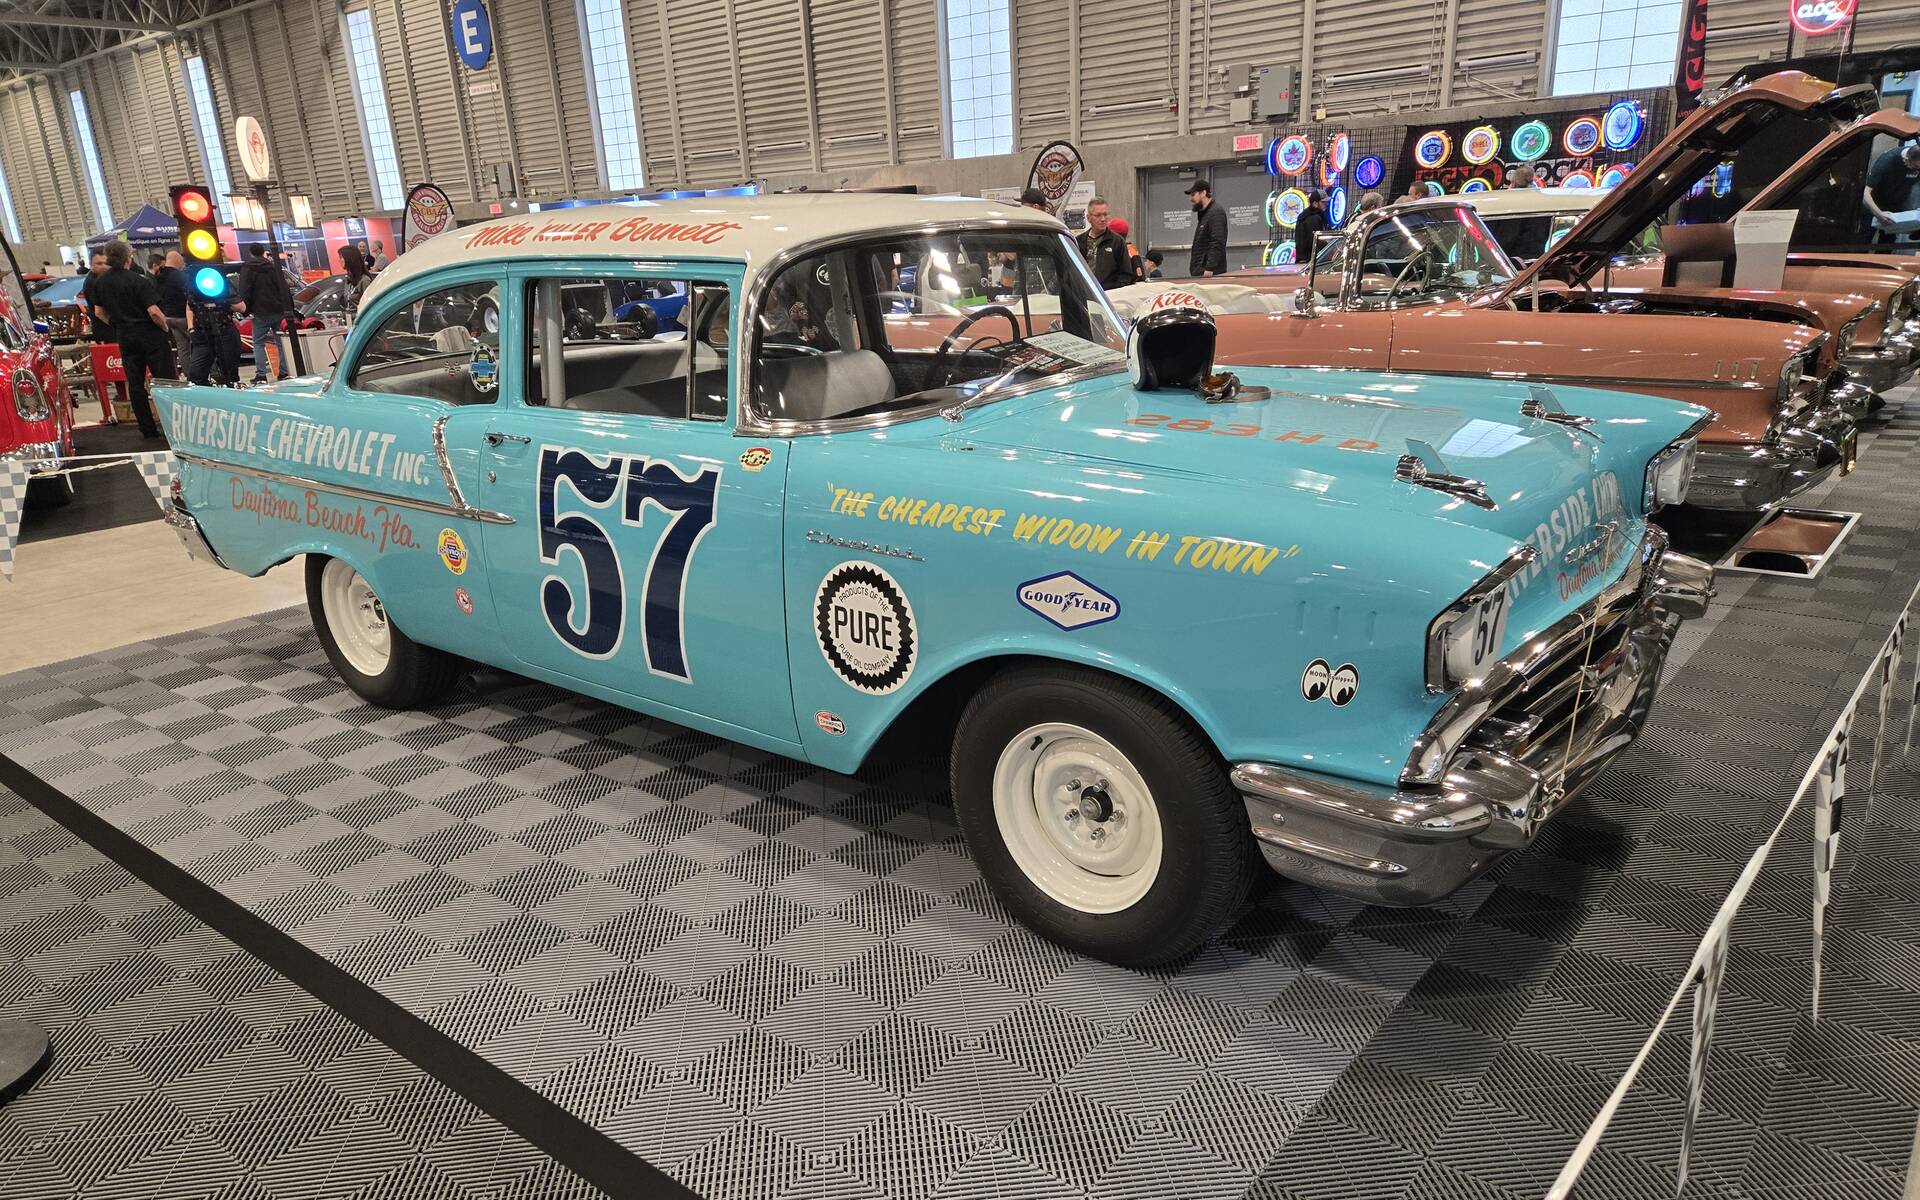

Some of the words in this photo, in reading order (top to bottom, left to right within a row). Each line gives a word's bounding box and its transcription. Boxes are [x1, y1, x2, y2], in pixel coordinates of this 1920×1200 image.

[461, 10, 483, 55] E
[465, 221, 535, 250] Mike
[609, 217, 743, 245] Bennett
[171, 402, 262, 455] RIVERSIDE
[267, 417, 398, 478] CHEVROLET
[392, 451, 431, 486] INC.
[1122, 413, 1264, 437] 283
[229, 477, 300, 525] Daytona
[305, 491, 376, 546] Beach,
[373, 505, 421, 554] Fla.
[876, 494, 1006, 538] CHEAPEST
[1012, 512, 1124, 555] WIDOW
[1125, 530, 1171, 562] IN
[536, 444, 724, 686] 57
[838, 586, 869, 604] PRODUCTS
[870, 590, 879, 600] OF
[878, 598, 890, 613] THE
[834, 604, 894, 652] PURE
[1474, 586, 1507, 666] 57
[839, 643, 854, 662] PURE
[853, 658, 863, 669] OIL
[864, 654, 892, 671] COMPANY
[1310, 670, 1327, 679] MOON
